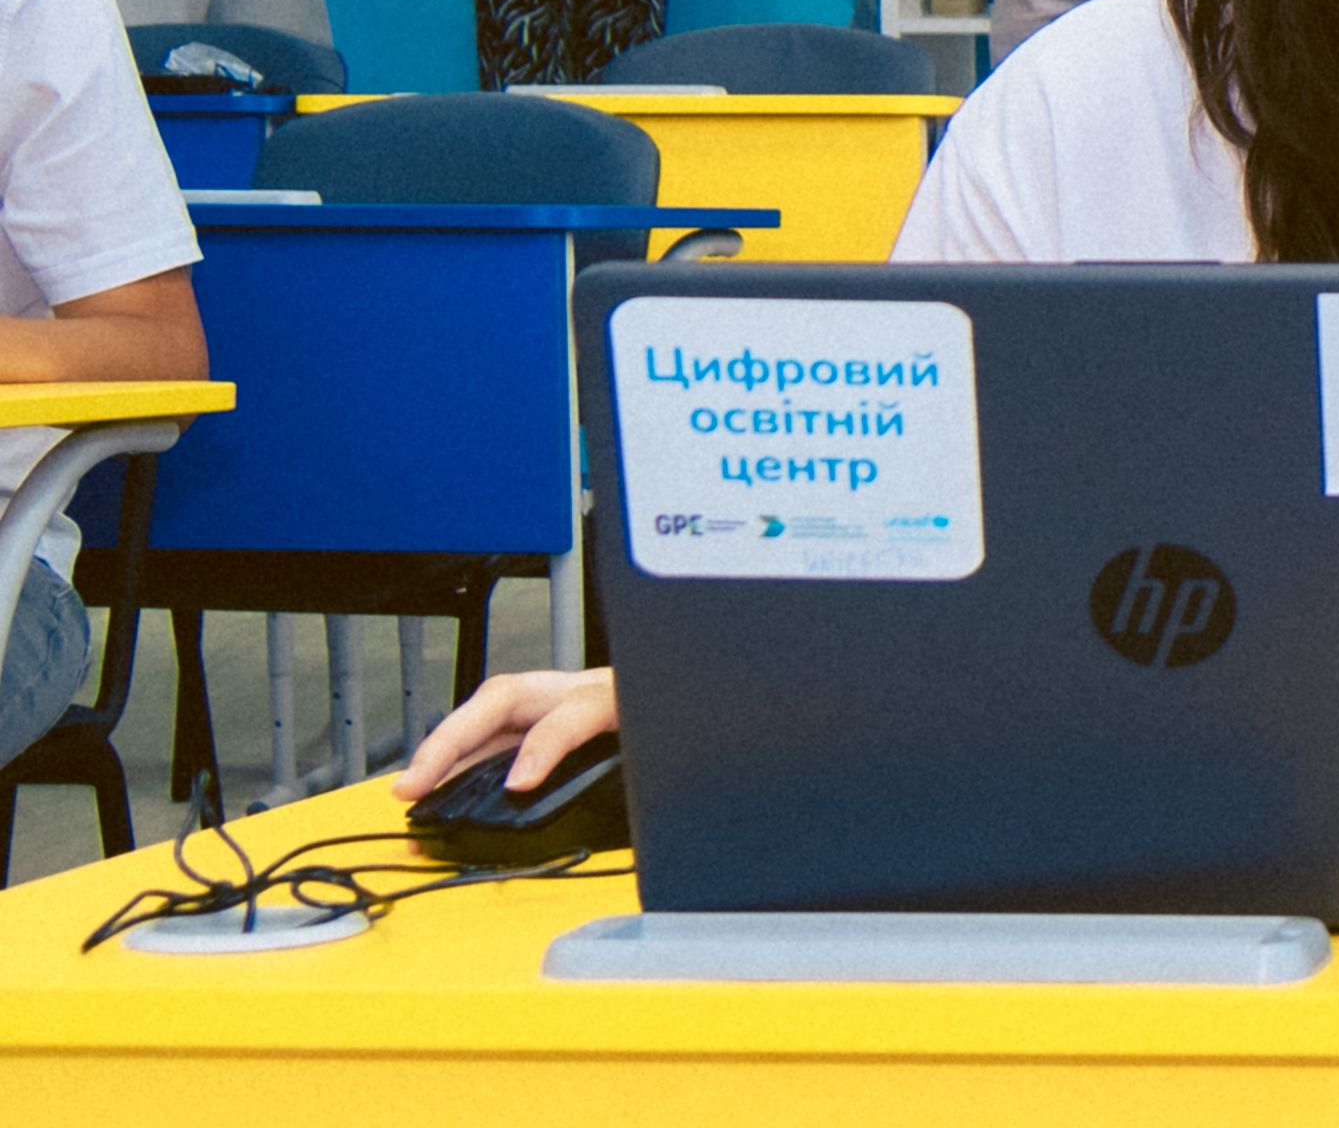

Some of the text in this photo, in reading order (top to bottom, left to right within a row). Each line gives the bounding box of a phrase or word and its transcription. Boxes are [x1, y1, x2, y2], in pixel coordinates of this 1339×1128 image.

[644, 346, 940, 393] Цифровий
[689, 398, 905, 438] освітній
[719, 455, 879, 492] центр
[655, 514, 703, 536] GPE
[1109, 545, 1222, 669] hp
